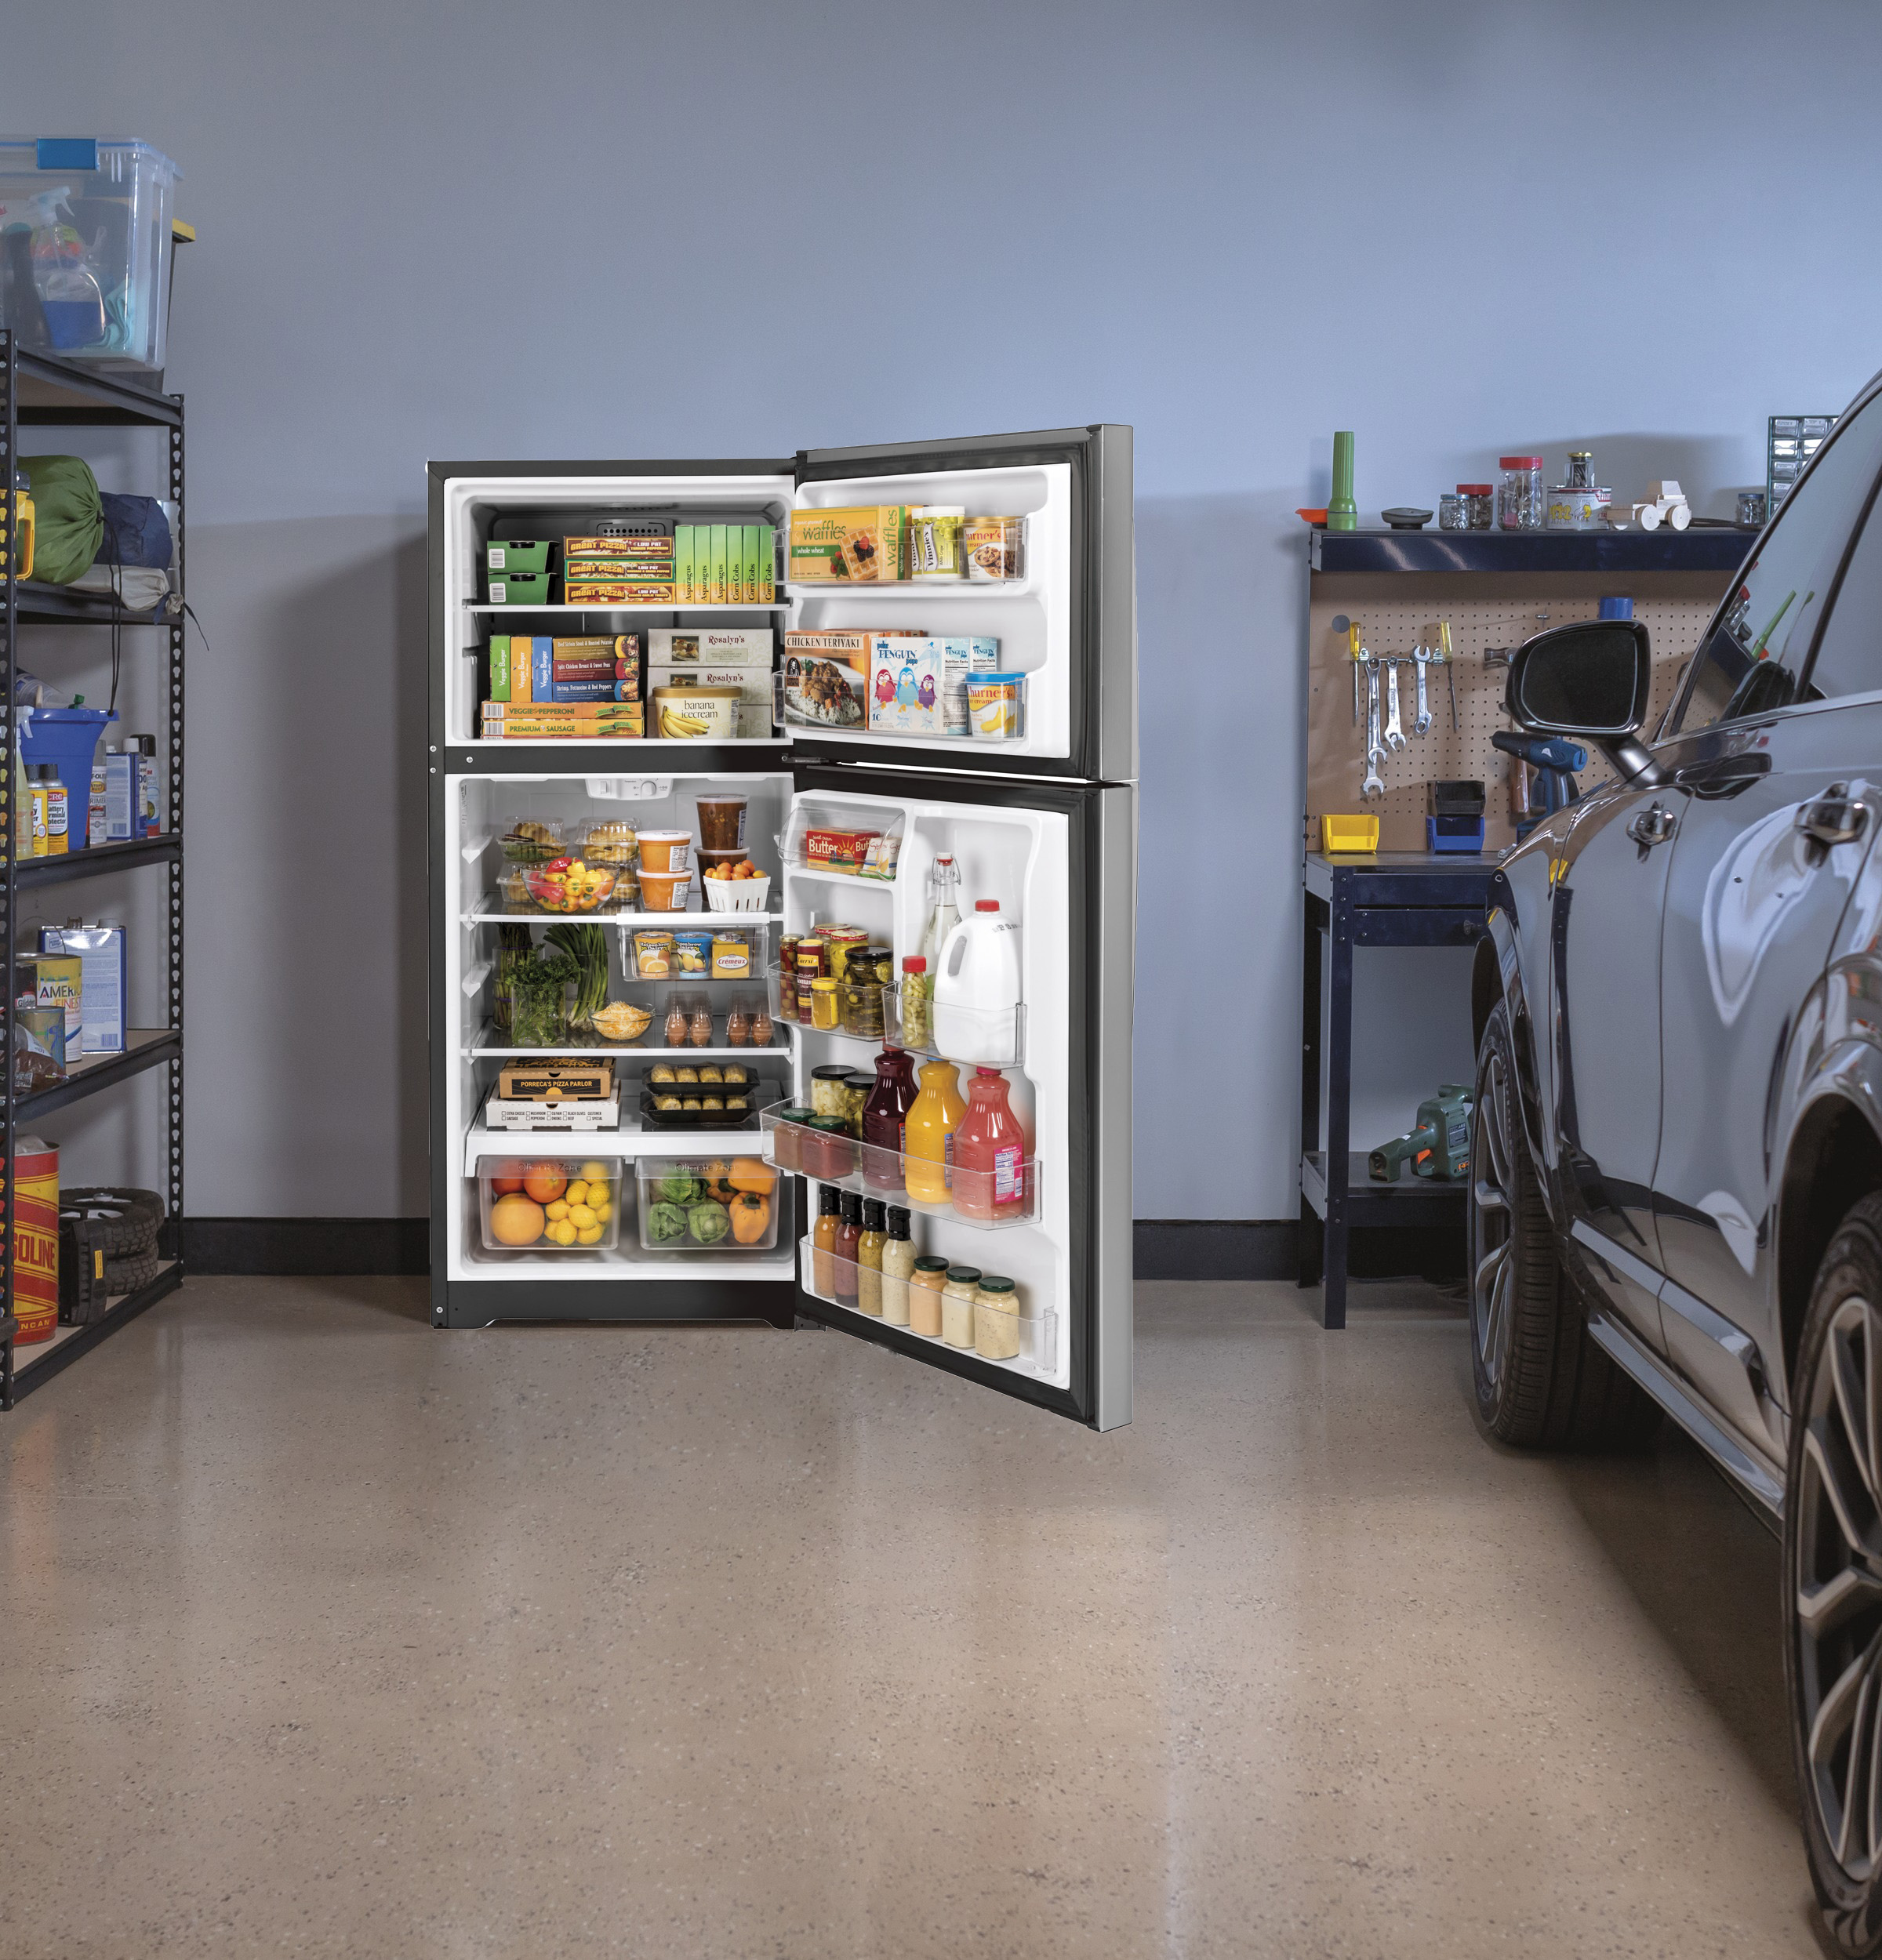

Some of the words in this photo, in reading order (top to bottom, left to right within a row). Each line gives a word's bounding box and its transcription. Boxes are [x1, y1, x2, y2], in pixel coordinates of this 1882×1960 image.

[803, 520, 847, 540] waffles
[882, 510, 897, 567] waffles
[570, 542, 598, 551] GREAT
[599, 542, 627, 550] PIZZA!
[924, 532, 934, 567] Vinnie's
[570, 565, 596, 574] GREAT
[598, 565, 625, 574] PIZZA!
[685, 564, 694, 601] Asparagus
[570, 589, 597, 598] GREAT
[598, 590, 625, 598] PIZZA!
[708, 635, 745, 645] Rosalyn's
[787, 637, 821, 647] CHICKEN
[823, 637, 860, 648] TERIYAKI
[877, 640, 889, 650] polar
[877, 649, 917, 659] PENGUIN
[499, 669, 507, 686] Veggie
[707, 673, 743, 683] Rosalyn's
[685, 699, 715, 710] banana
[681, 710, 718, 719] icecream
[808, 839, 838, 854] Butter
[40, 985, 81, 999] AMERI
[518, 1163, 555, 1171] Climate
[676, 1163, 714, 1171] Climate
[14, 1232, 56, 1271] SOLINE
